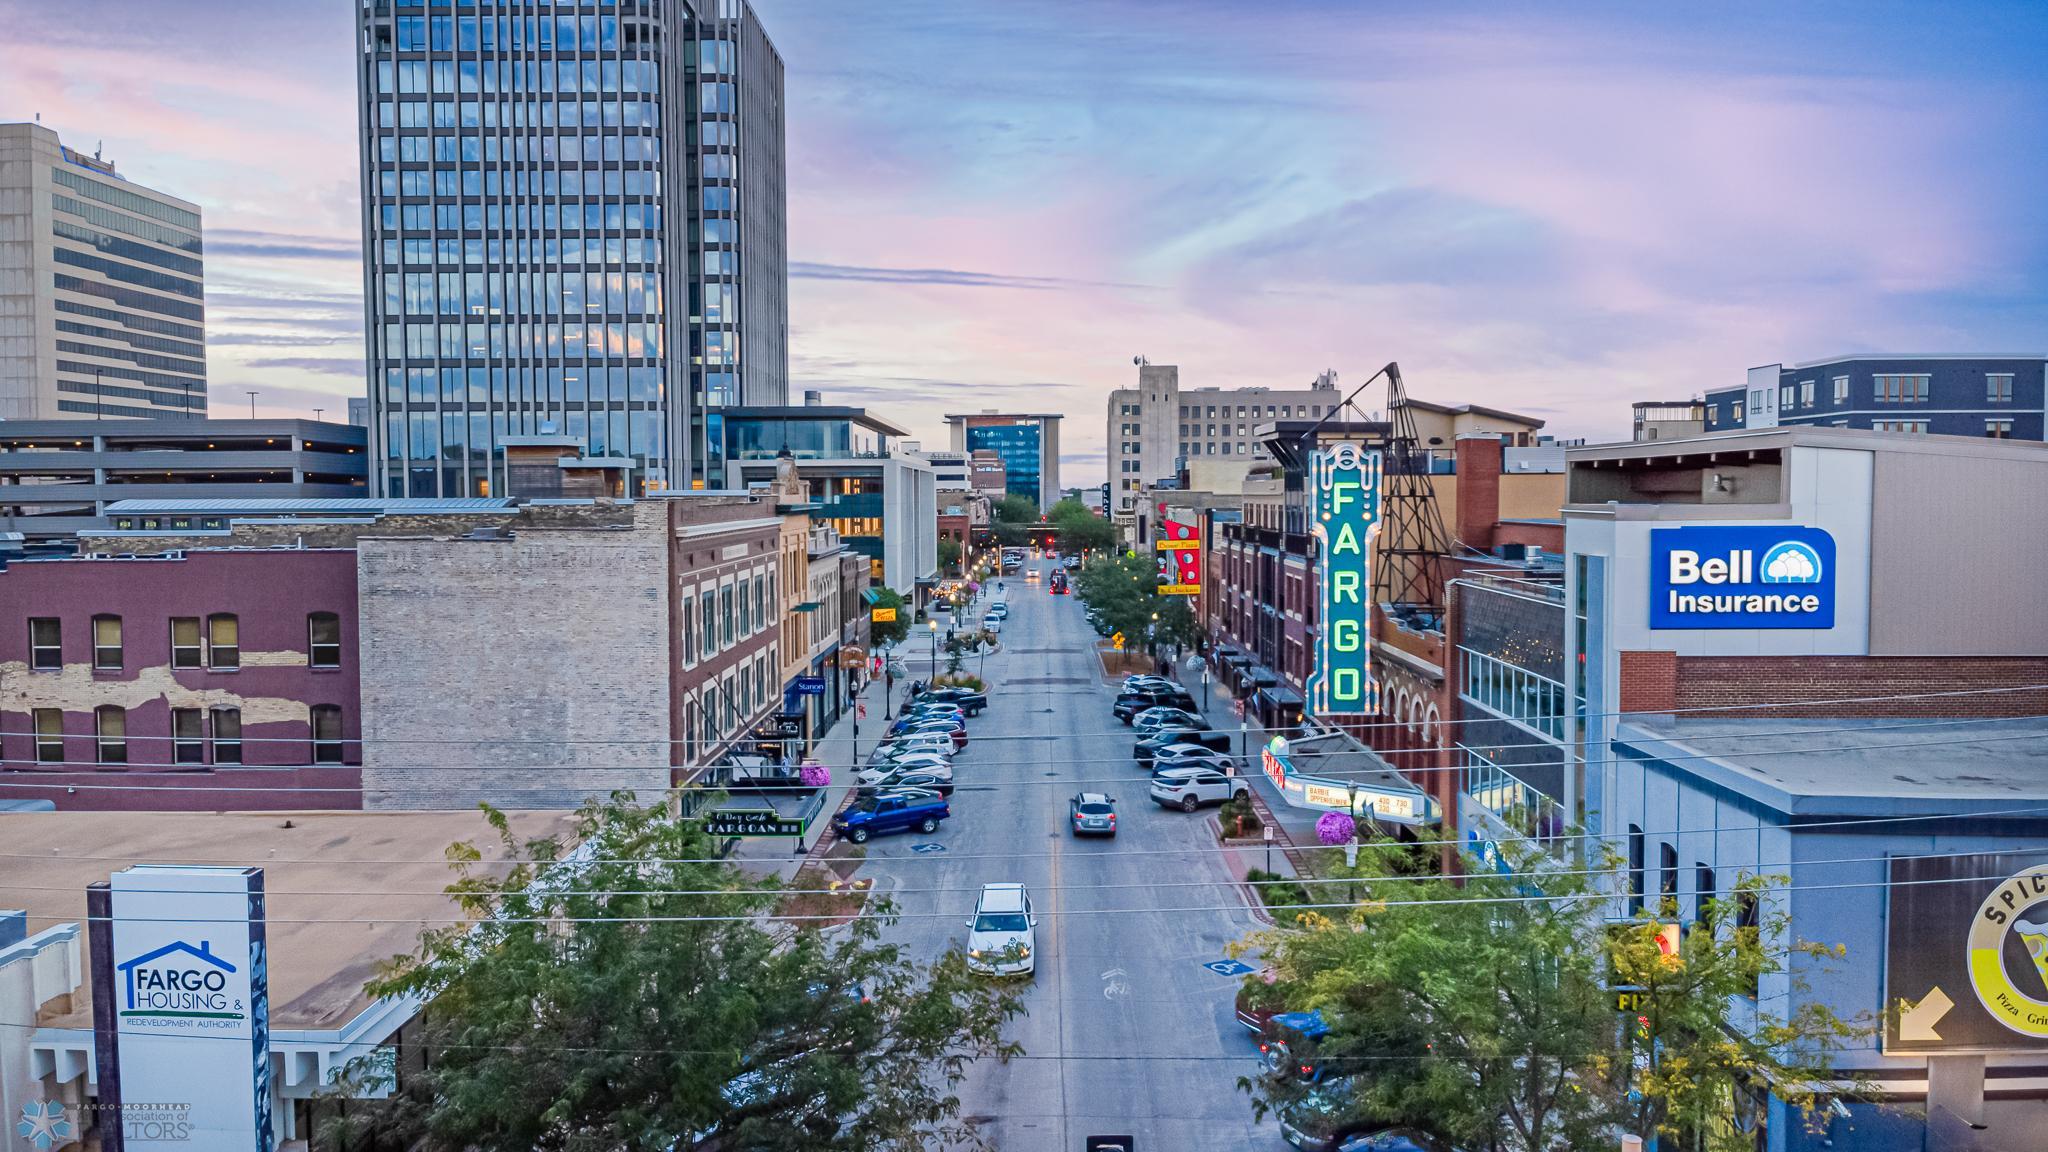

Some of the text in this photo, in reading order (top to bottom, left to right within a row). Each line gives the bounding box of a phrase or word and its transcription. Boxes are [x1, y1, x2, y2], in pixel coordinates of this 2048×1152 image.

[1669, 549, 1753, 585] Bell
[1333, 482, 1361, 701] FARGO
[1669, 590, 1820, 613] Insurance
[137, 969, 226, 991] FARGO
[137, 992, 243, 1010] HOUSING &
[1996, 992, 2019, 1016] Pizza
[127, 1018, 242, 1029] REDEVELOPMENT AUTHORITY
